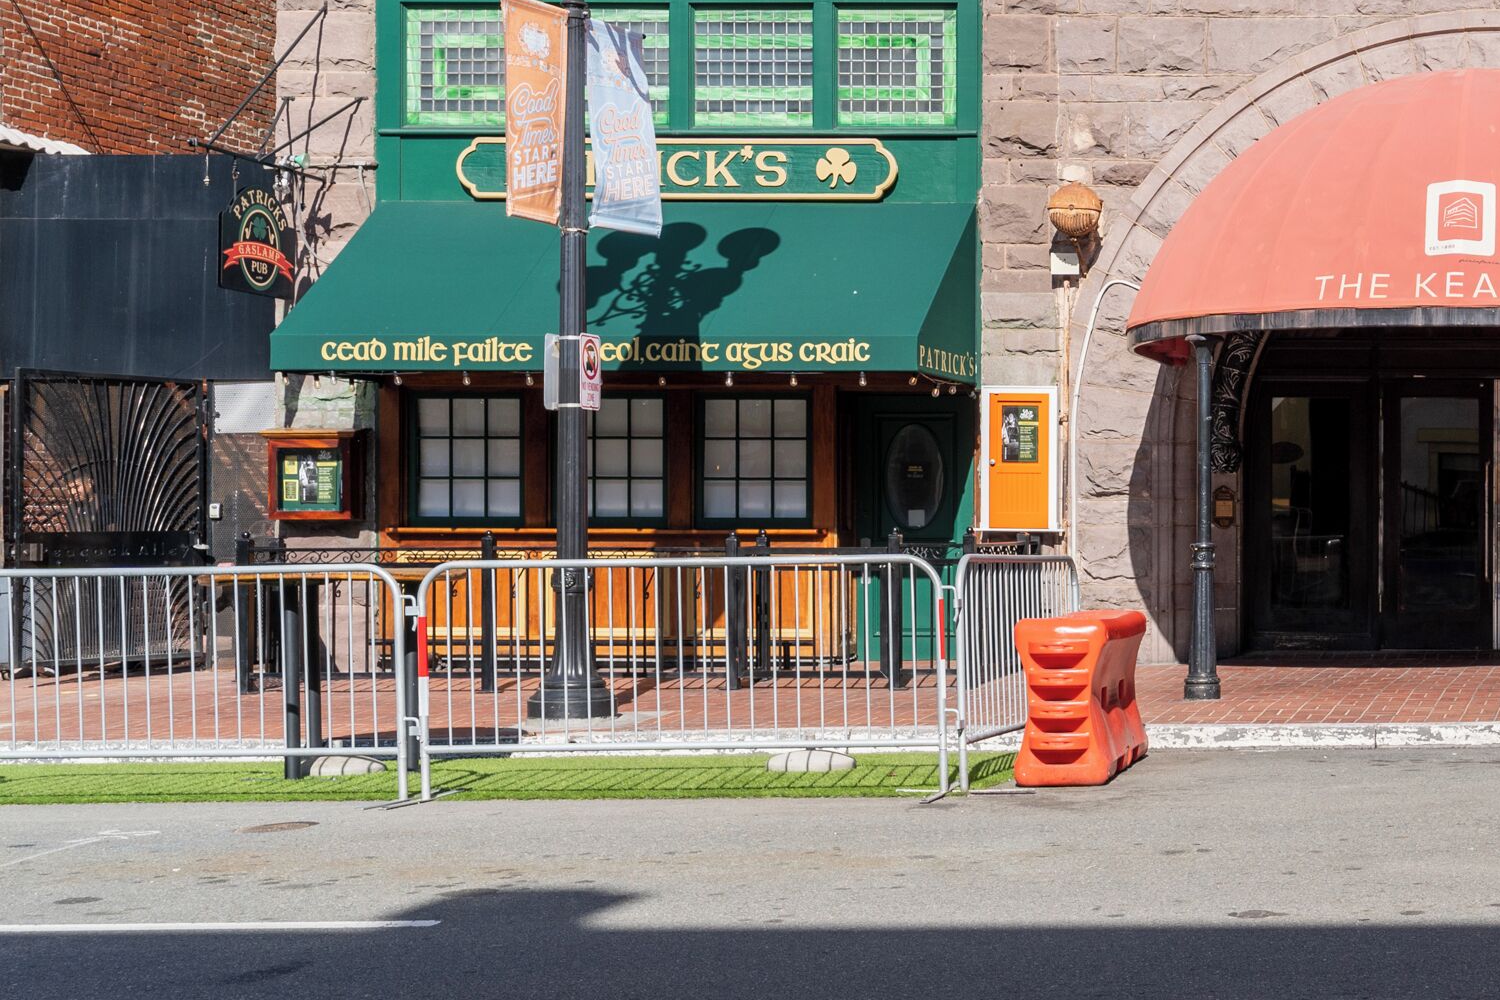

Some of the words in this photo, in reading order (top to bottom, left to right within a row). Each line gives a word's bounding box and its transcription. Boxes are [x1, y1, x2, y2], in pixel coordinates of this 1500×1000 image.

[512, 83, 558, 119] Good
[515, 117, 556, 146] Times
[599, 104, 642, 135] Good
[513, 143, 558, 166] START
[603, 135, 648, 166] Times
[512, 159, 558, 191] HERE
[606, 158, 653, 180] START
[603, 174, 656, 204] HERE
[238, 243, 281, 262] GASLAMP
[251, 260, 269, 275] PUB
[1314, 272, 1391, 300] THE
[394, 336, 447, 362] mile
[725, 341, 794, 369] agus
[919, 344, 975, 377] PATRICK'S
